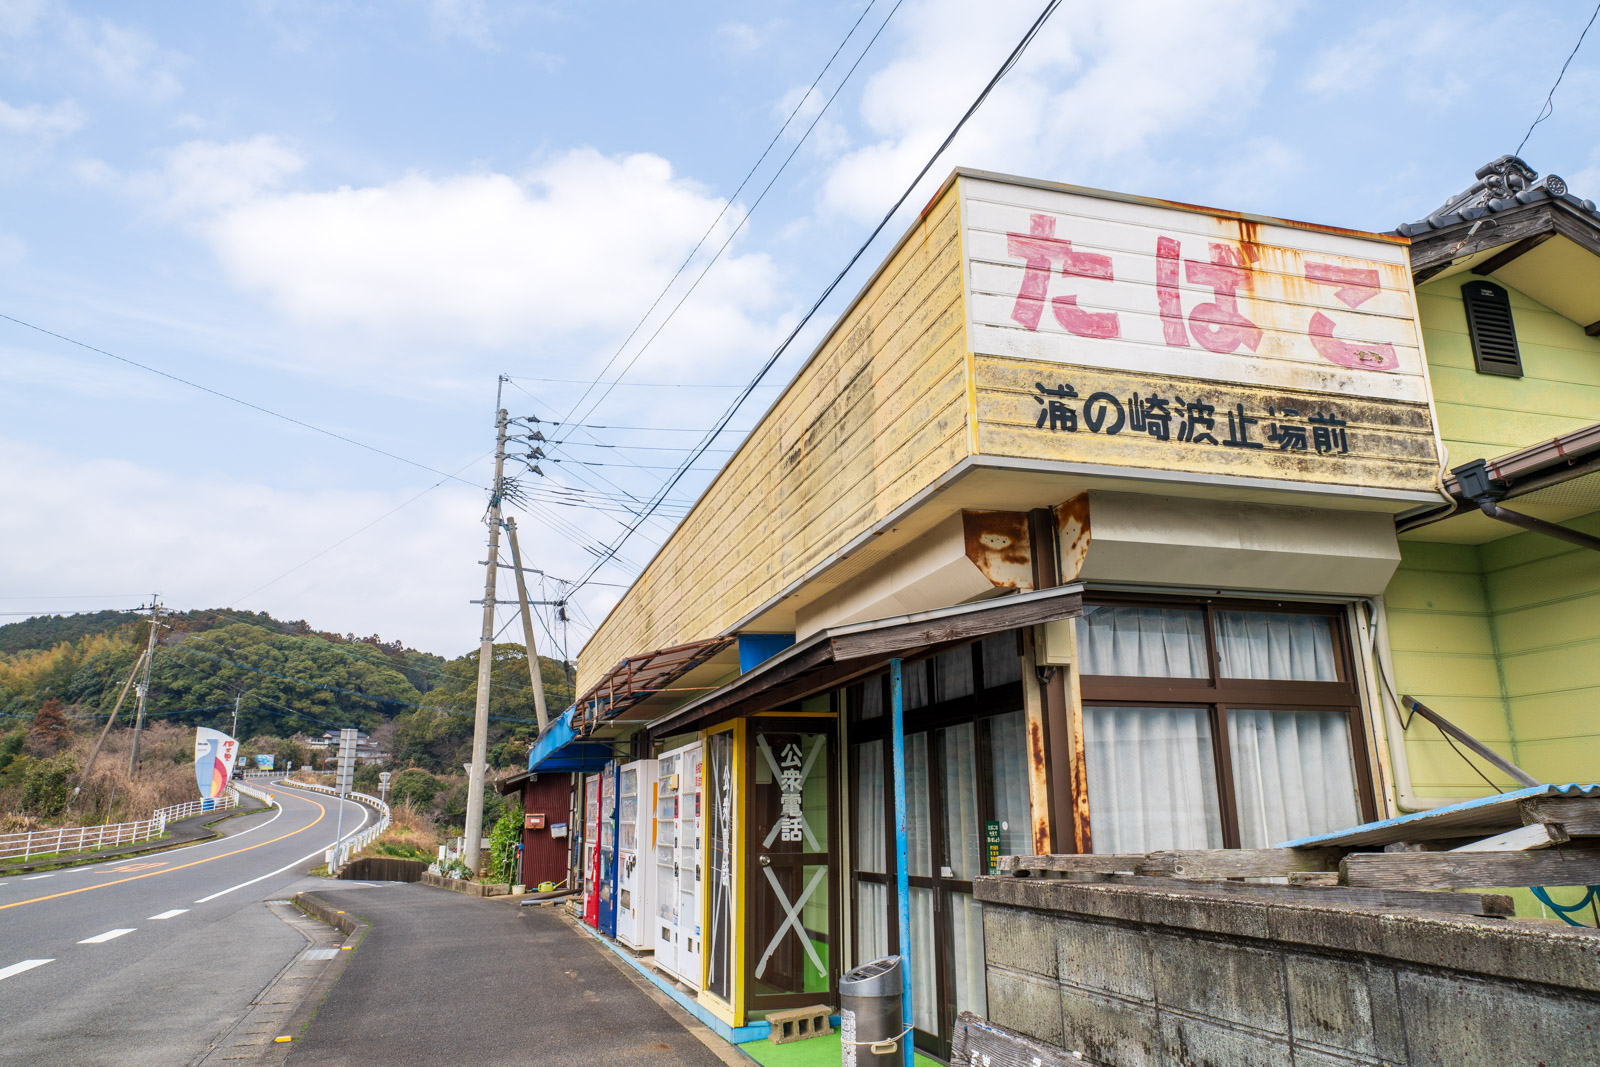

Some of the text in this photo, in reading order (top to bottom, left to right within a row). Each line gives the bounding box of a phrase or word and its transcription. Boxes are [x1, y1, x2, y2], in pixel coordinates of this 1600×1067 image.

[1007, 213, 1400, 371] たばこ
[1034, 382, 1348, 455] 浦の崎波止場前
[781, 743, 803, 842] 公衆電話
